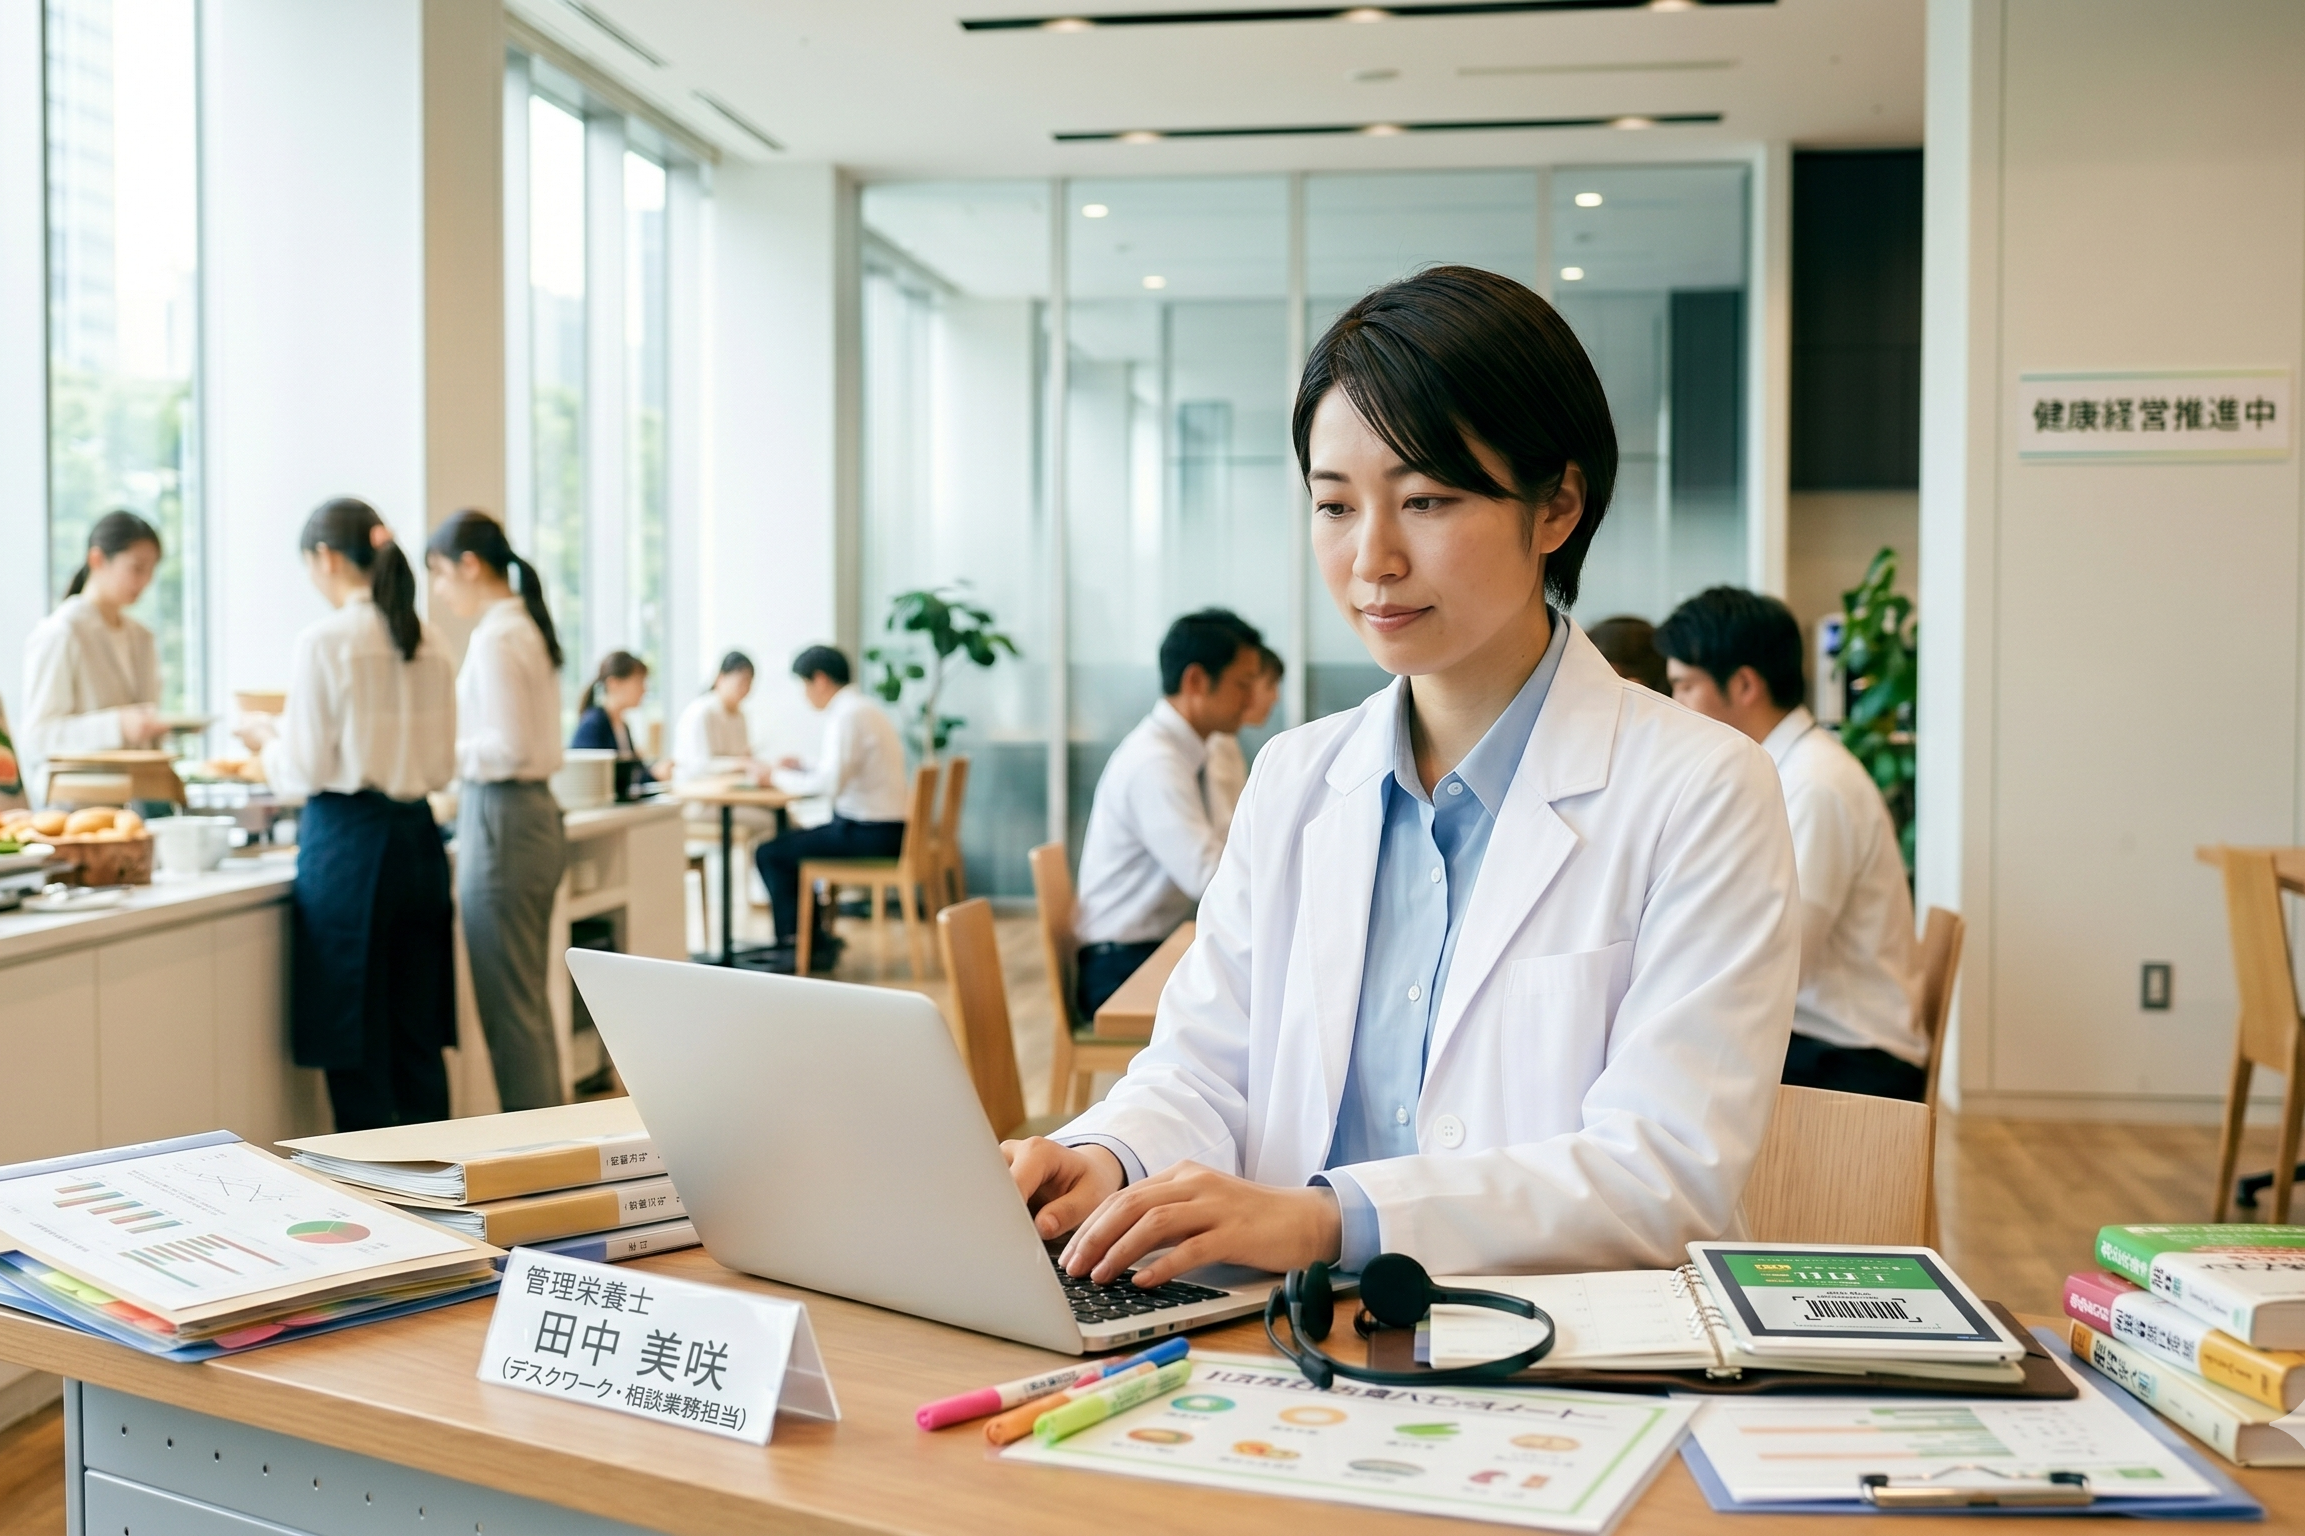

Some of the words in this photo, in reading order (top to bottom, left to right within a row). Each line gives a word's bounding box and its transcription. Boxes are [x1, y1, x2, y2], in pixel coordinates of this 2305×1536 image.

[2033, 396, 2276, 433] 健康経営推進中
[525, 1264, 655, 1316] 管理栄養士
[534, 1310, 621, 1367] 田中
[636, 1328, 729, 1391] 美咲
[502, 1356, 747, 1432] (デスクワーク・相談業務担当)
